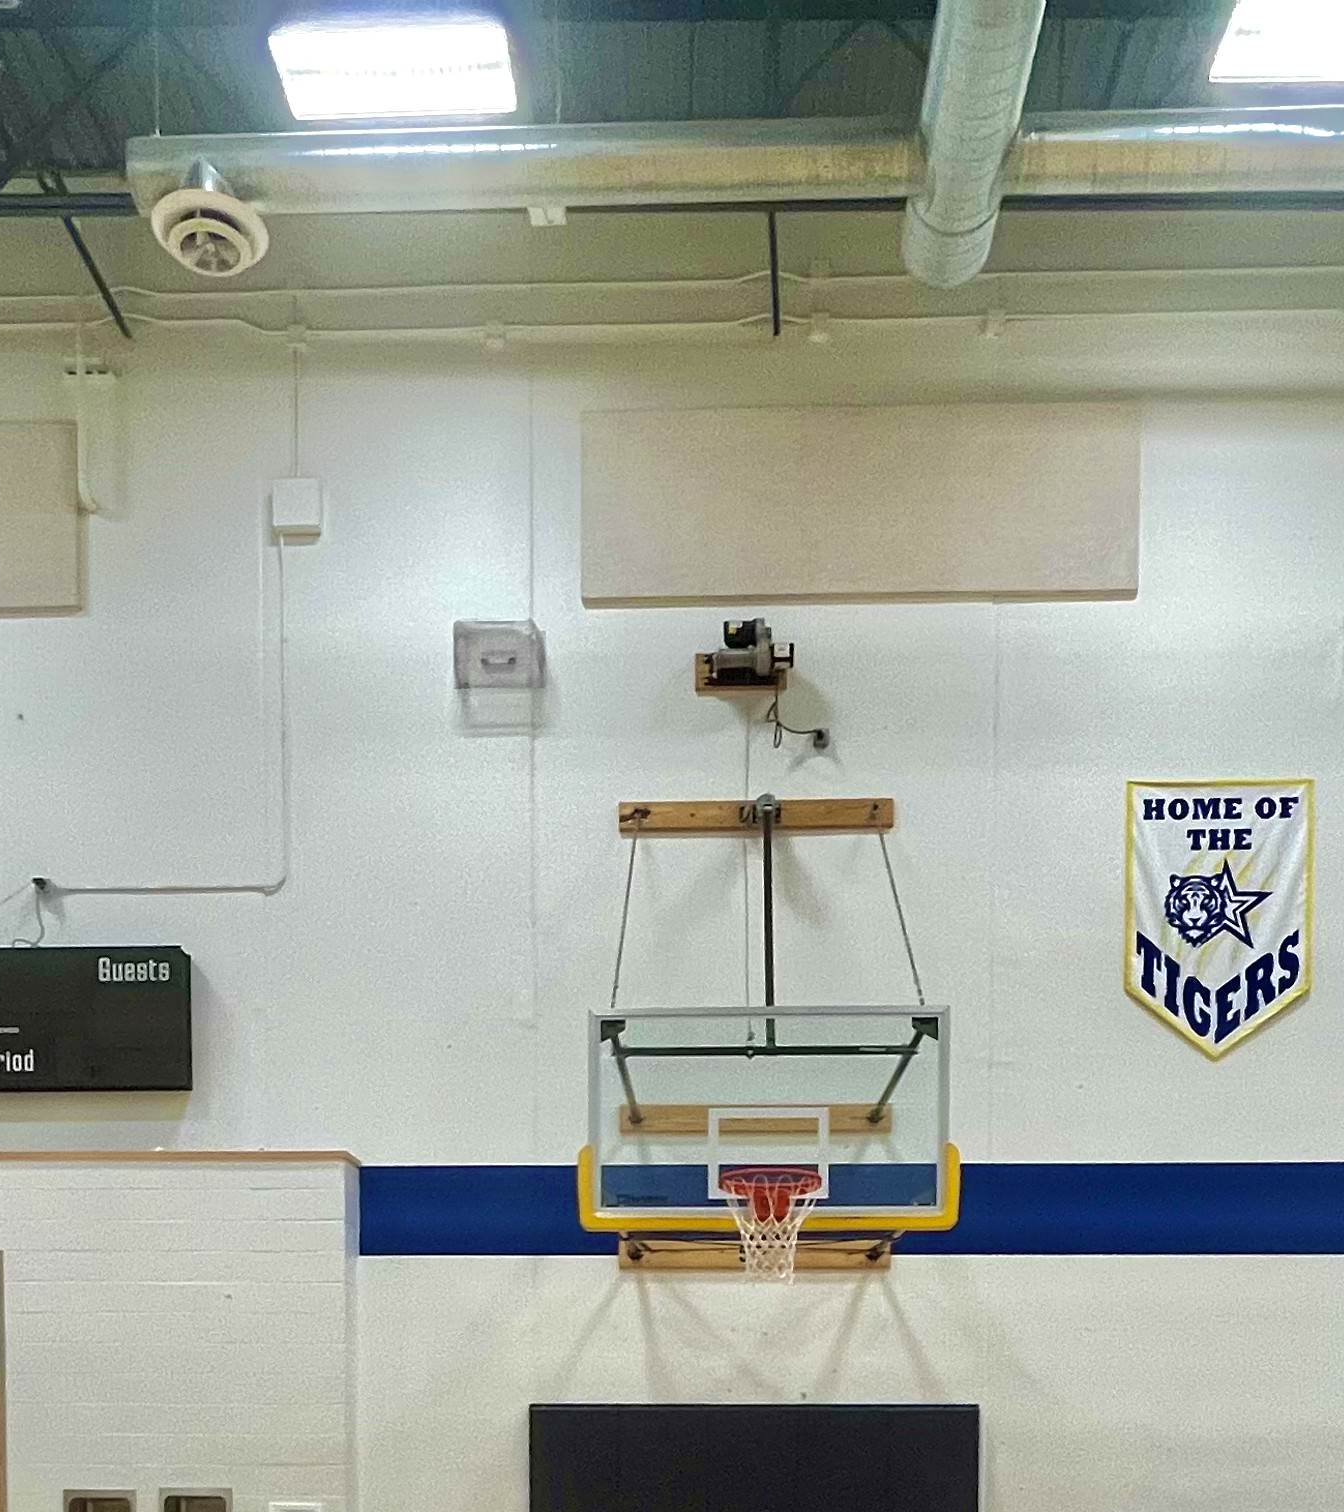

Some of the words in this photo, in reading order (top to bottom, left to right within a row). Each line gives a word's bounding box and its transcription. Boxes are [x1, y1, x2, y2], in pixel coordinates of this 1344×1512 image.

[1142, 797, 1242, 820] HOME
[1254, 796, 1299, 819] OF
[1186, 828, 1252, 850] THE
[97, 957, 170, 982] Guests
[1136, 929, 1300, 1044] TIGERS
